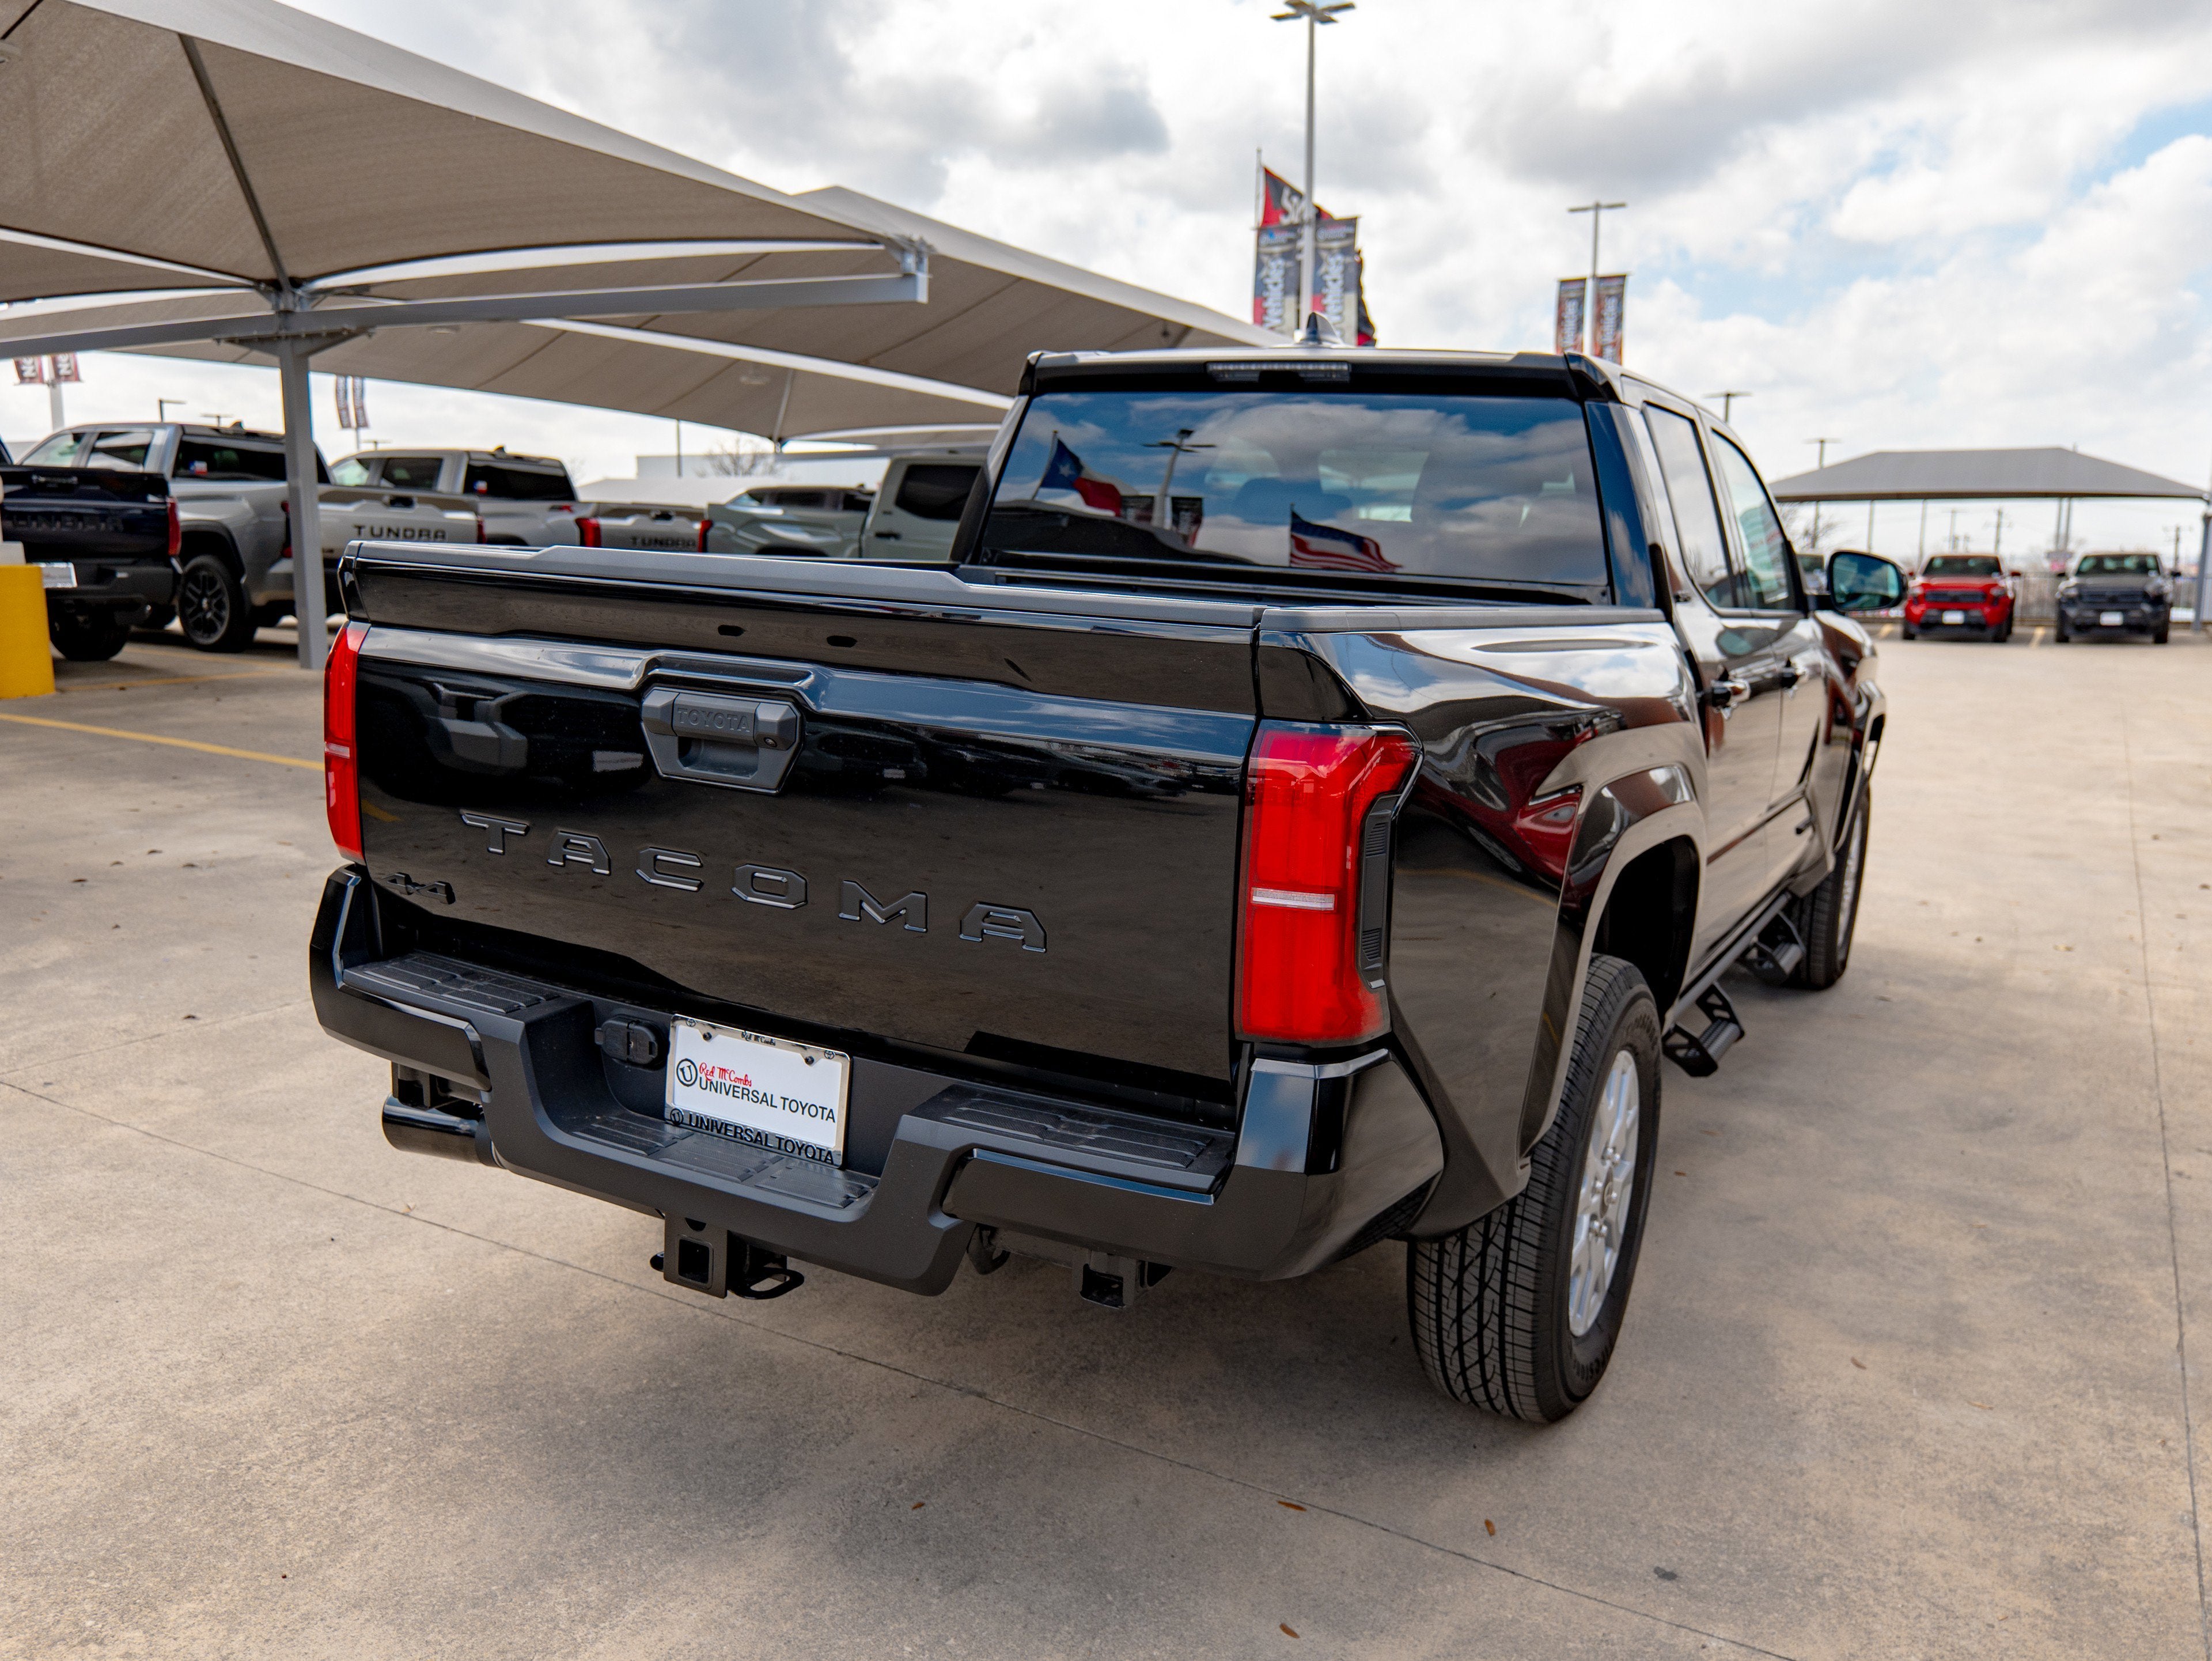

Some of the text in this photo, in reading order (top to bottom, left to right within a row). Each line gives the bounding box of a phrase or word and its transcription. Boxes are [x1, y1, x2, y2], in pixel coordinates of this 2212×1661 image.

[353, 525, 448, 540] TUNDRA
[631, 536, 696, 548] TUNDRA
[677, 707, 750, 732] TOYOTA
[461, 811, 1047, 953] TACOMA
[699, 1062, 752, 1087] Red McCombs
[699, 1076, 835, 1123] UNIVERSAL TOYOTA
[689, 1112, 834, 1165] UNIVERSAL TOYOTA
